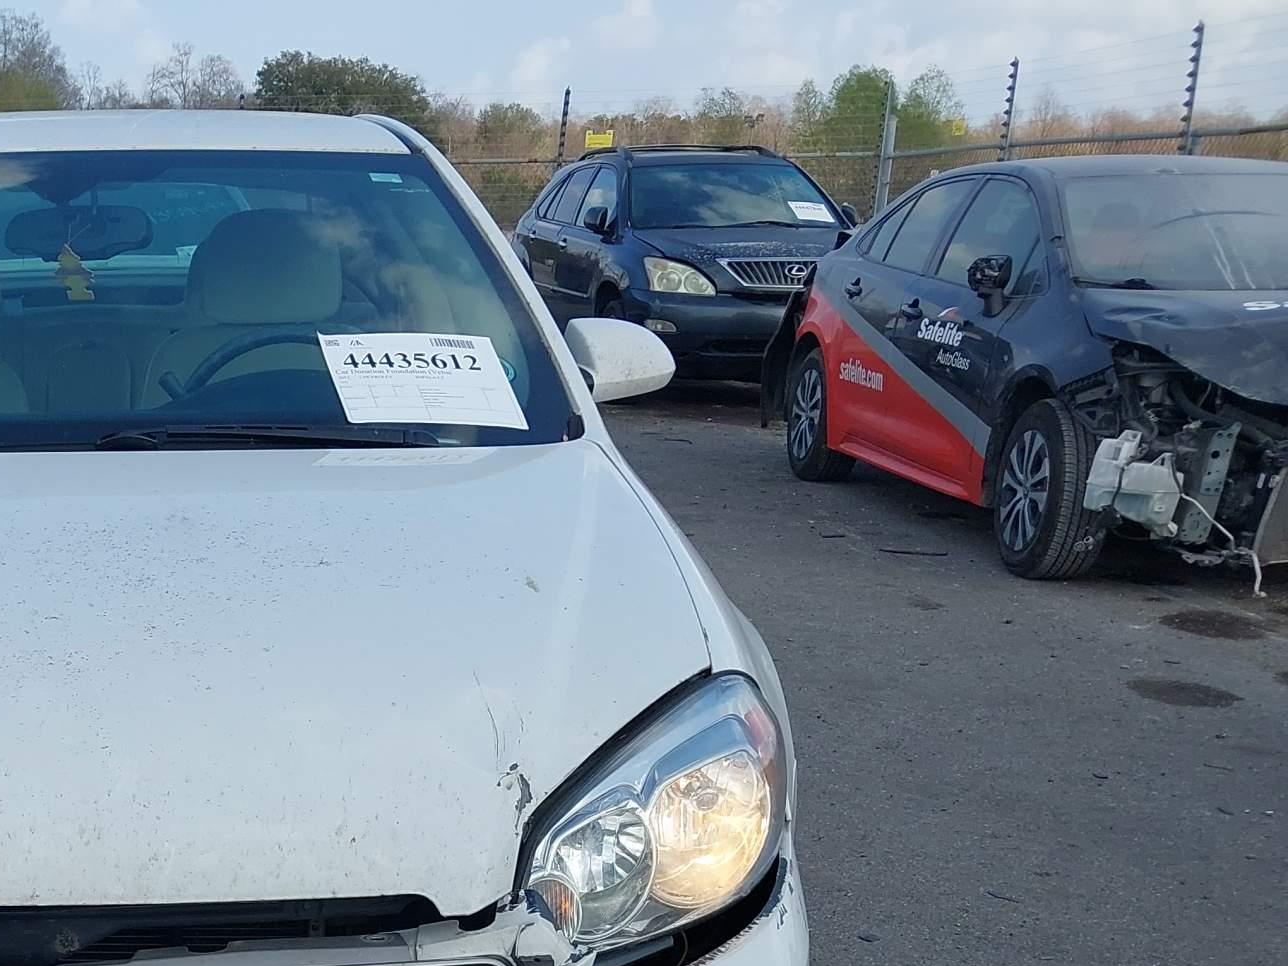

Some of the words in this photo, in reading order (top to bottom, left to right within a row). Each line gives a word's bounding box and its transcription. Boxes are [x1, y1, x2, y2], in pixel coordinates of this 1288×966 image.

[917, 318, 963, 347] Safelite
[344, 352, 481, 371] 44435612
[936, 348, 970, 370] AutoGlass
[839, 358, 883, 392] safelite.com
